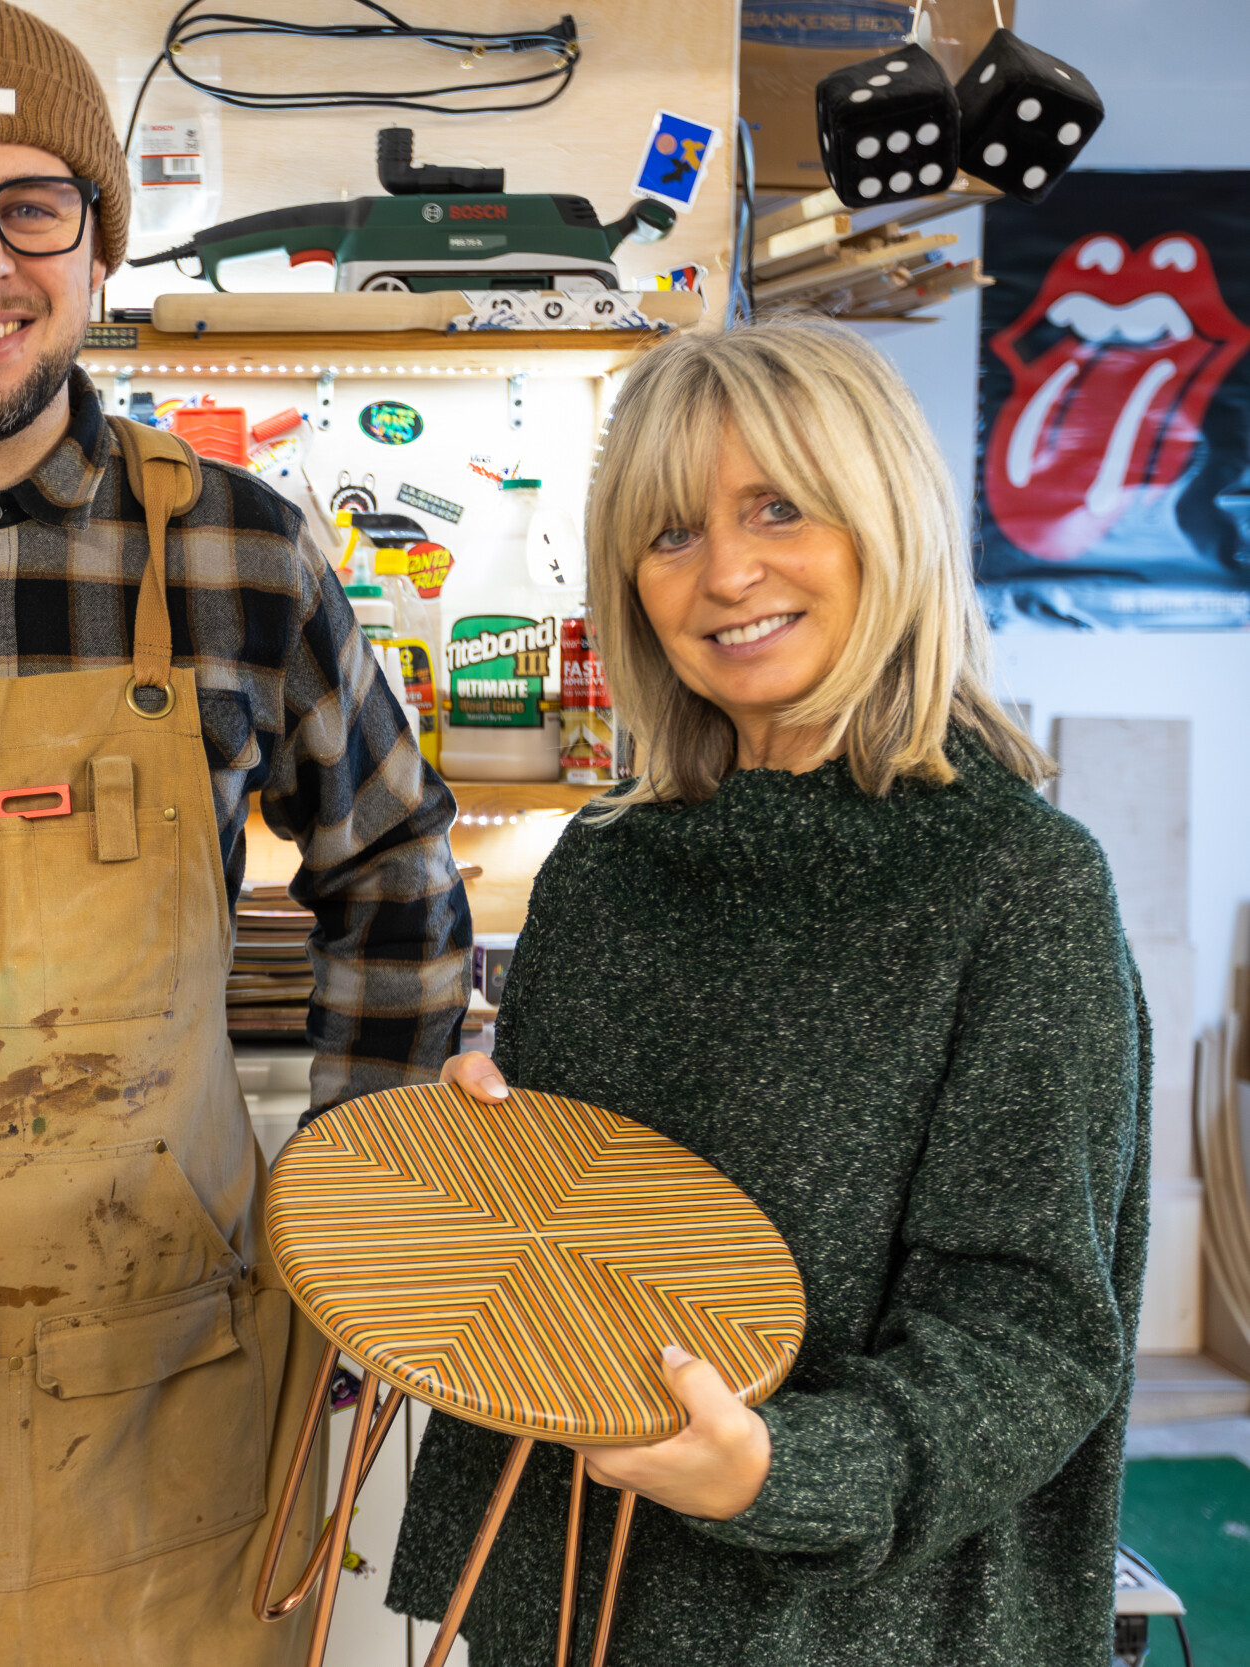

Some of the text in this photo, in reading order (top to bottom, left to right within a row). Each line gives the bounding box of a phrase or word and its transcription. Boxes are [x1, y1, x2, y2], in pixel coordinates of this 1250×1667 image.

[856, 14, 906, 32] BOX
[450, 204, 507, 220] BOSCH
[447, 618, 554, 669] Titebond
[516, 651, 549, 676] III
[563, 660, 603, 677] FAST
[457, 678, 529, 699] ULTIMATE
[459, 700, 525, 714] Wood Glue
